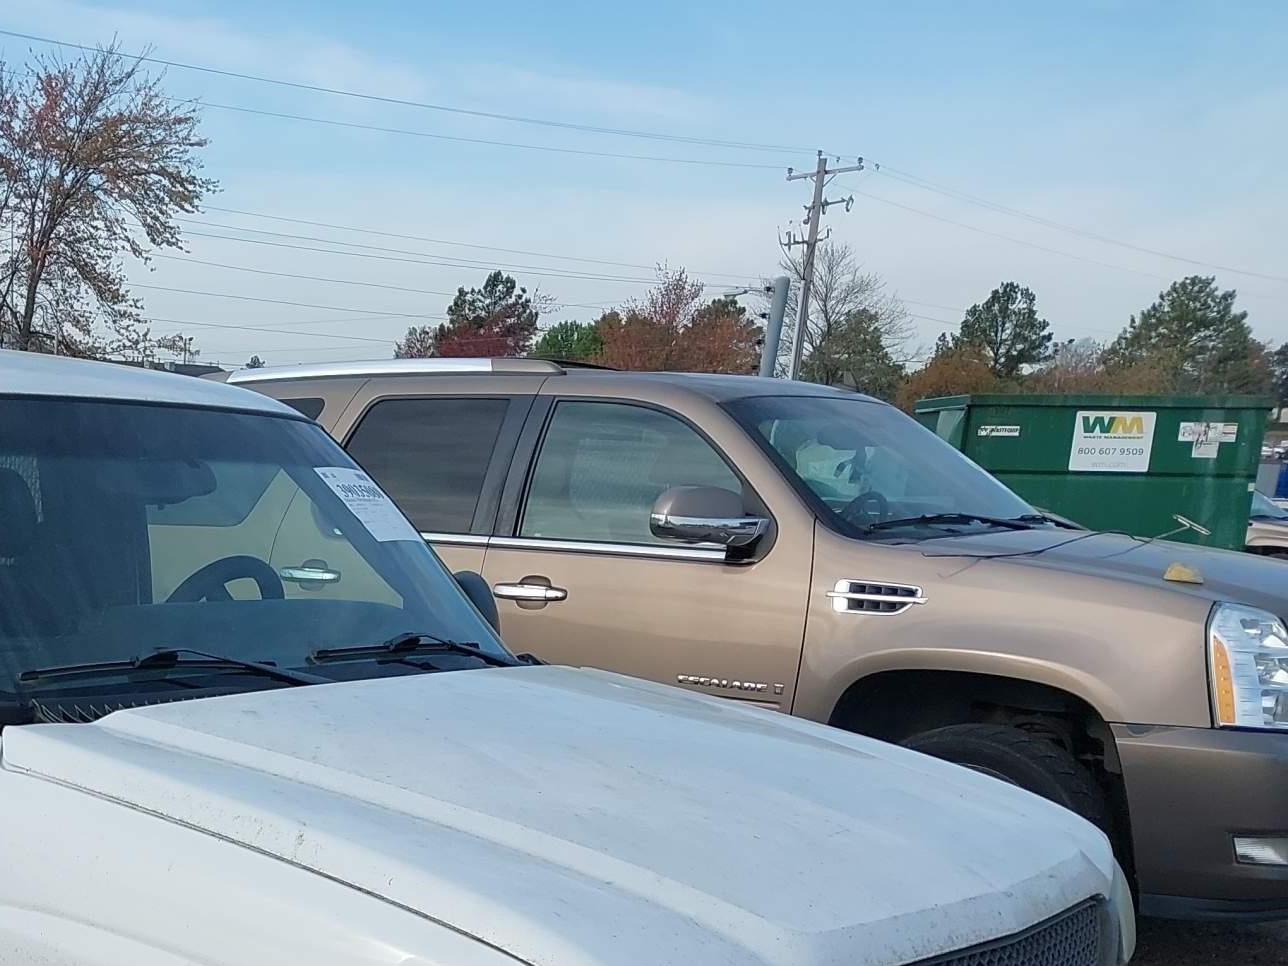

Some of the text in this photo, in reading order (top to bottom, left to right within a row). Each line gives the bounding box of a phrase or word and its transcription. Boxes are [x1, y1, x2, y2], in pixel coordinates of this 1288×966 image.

[1082, 416, 1144, 434] WM
[1077, 447, 1144, 456] 800 607 9509
